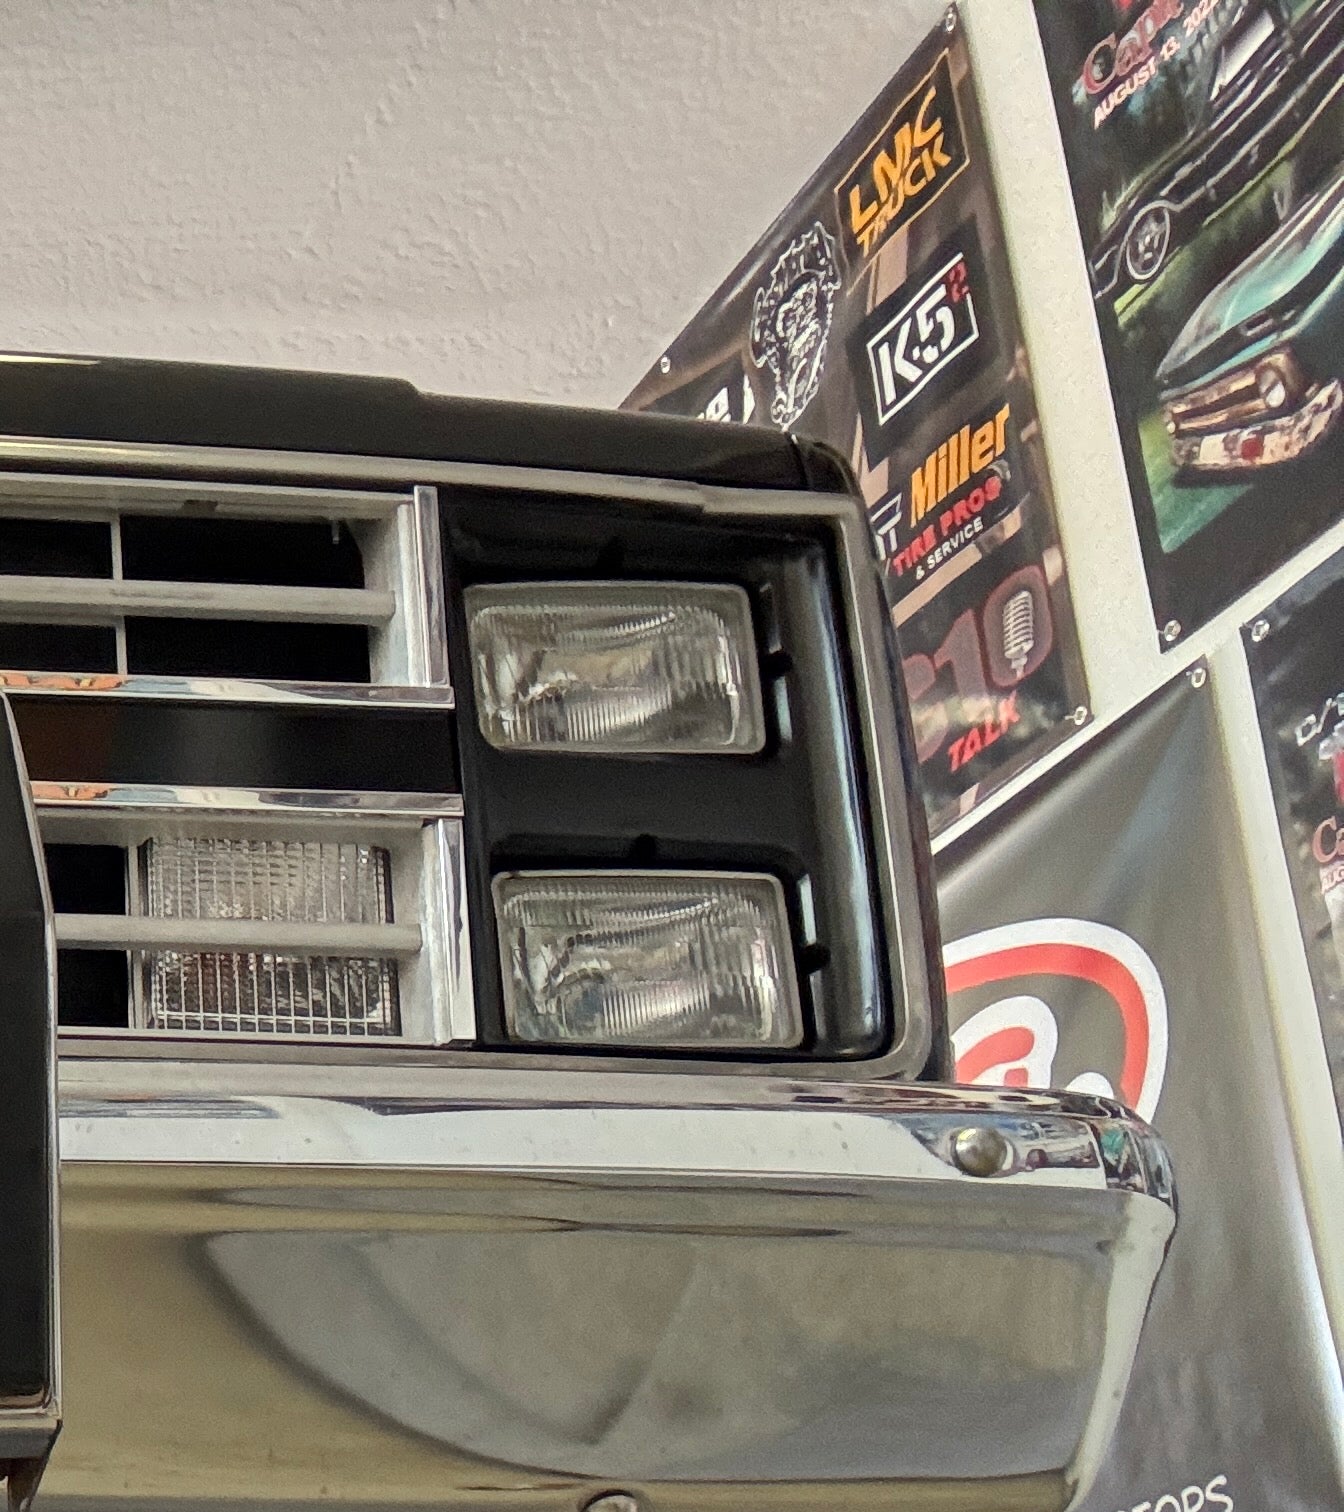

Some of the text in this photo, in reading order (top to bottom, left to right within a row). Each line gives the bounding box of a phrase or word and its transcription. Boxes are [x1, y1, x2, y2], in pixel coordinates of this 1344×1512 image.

[1094, 57, 1157, 130] AUGUST
[850, 86, 942, 234] LMC
[857, 133, 952, 257] TRUCK
[911, 403, 1009, 528] Miller
[892, 524, 937, 577] TIRE
[940, 476, 1002, 536] PROS
[916, 565, 925, 580] &
[927, 516, 983, 570] SERVICE
[948, 690, 1021, 774] TALK
